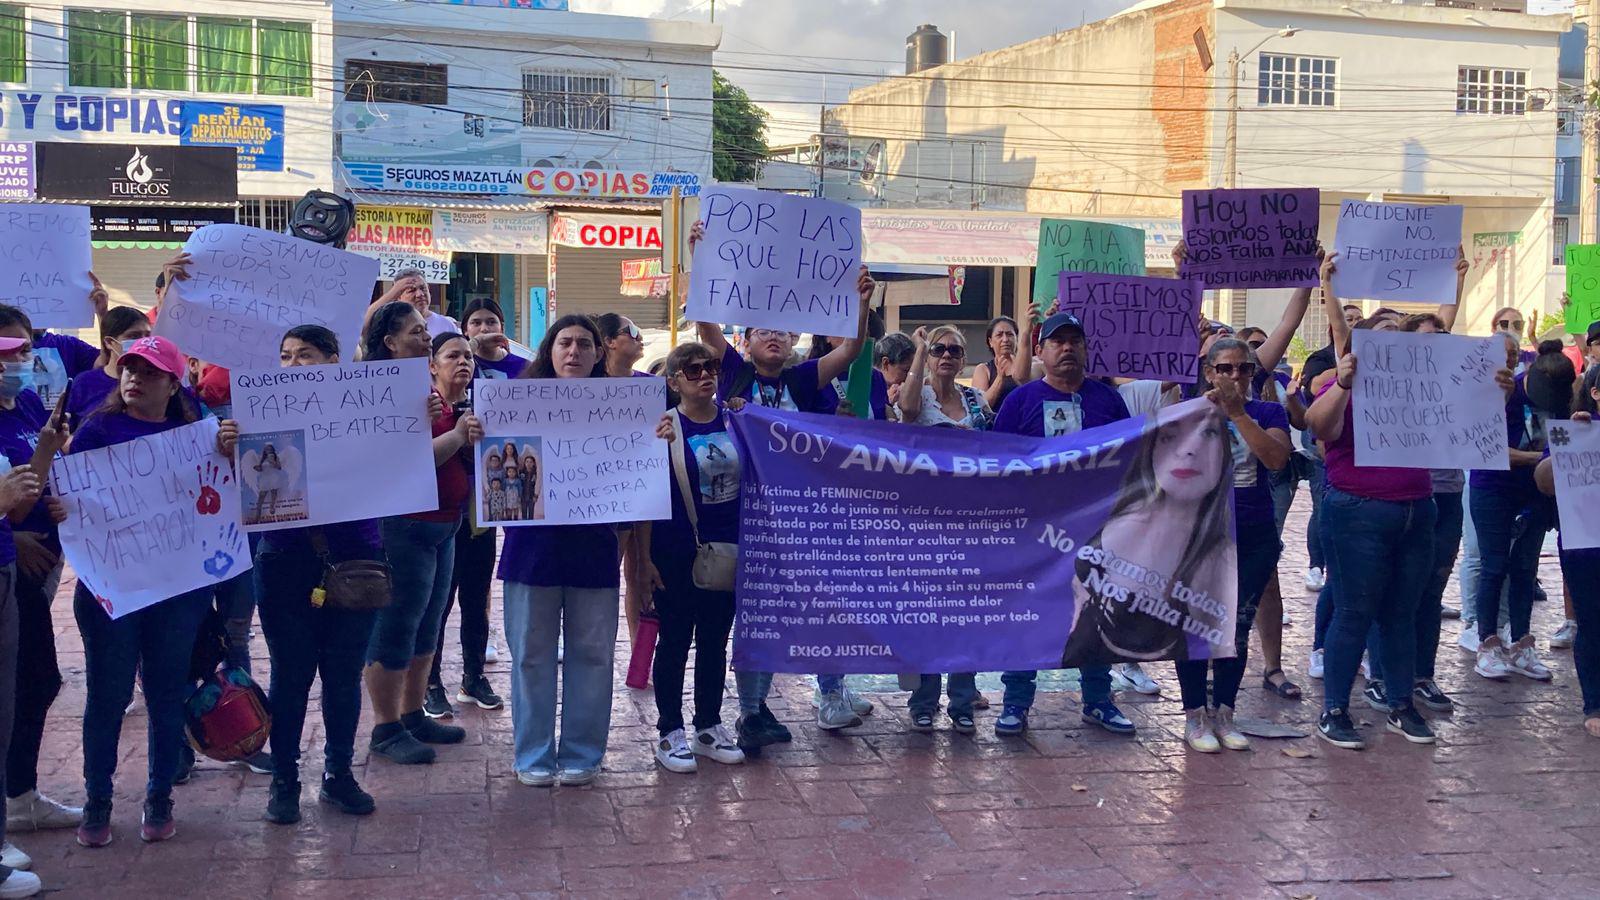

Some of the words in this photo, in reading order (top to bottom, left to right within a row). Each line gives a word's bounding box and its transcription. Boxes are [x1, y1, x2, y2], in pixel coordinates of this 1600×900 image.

[17, 93, 42, 129] Y
[55, 95, 180, 136] COPIAS
[198, 114, 265, 126] RENTAN
[223, 106, 240, 116] SE
[192, 124, 271, 141] DEPARTAMENTOS
[386, 167, 450, 181] SEGUROS
[453, 169, 522, 184] MAZATLÁN
[527, 170, 650, 195] COPIAS
[112, 182, 169, 195] FUEGO'S
[650, 184, 681, 196] REPUE
[1260, 193, 1298, 215] NO
[1342, 202, 1435, 221] ACCIDENTE
[356, 209, 393, 223] ESTORÍA
[396, 211, 402, 223] Y
[705, 193, 778, 235] POR
[799, 208, 854, 251] LAS
[347, 224, 383, 244] BLAS
[1044, 224, 1072, 248] NO
[1084, 227, 1094, 251] A
[1099, 229, 1121, 254] LA
[196, 229, 223, 243] NO
[241, 233, 348, 277] ESTAMOS
[351, 244, 387, 252] GESTOR
[1183, 247, 1222, 264] NOS
[1346, 245, 1457, 262] FEMINICIDIO
[206, 249, 291, 280] TODAS
[304, 273, 348, 296] NOS
[719, 239, 780, 270] QUE
[797, 248, 853, 287] HOY
[19, 271, 66, 290] ANA
[193, 271, 255, 294] FALTA
[265, 283, 316, 307] ANA
[1383, 268, 1419, 291] SI
[1066, 275, 1194, 313] EXIGIMOS
[1117, 351, 1198, 377] BEATRIZ
[1362, 340, 1398, 373] QUE
[1405, 345, 1438, 374] SER
[238, 369, 325, 388] Queremos
[480, 384, 595, 406] QUEREMOS
[600, 384, 667, 402] JUSTICIA
[1420, 381, 1443, 403] NO
[247, 391, 325, 420] PARA
[340, 385, 395, 409] ANA
[483, 409, 538, 424] PARA
[548, 409, 575, 423] MI
[1363, 406, 1398, 427] NOS
[311, 415, 421, 441] BEATRIZ
[547, 431, 651, 459] VICTOR
[768, 420, 834, 463] Soy
[840, 444, 939, 477] ANA
[952, 437, 1126, 477] BEATRIZ
[1366, 431, 1391, 451] LA
[1395, 432, 1432, 449] VIDA
[53, 452, 103, 496] ELLA
[108, 437, 156, 481] NO
[549, 467, 594, 484] NOS
[549, 489, 557, 501] A
[567, 478, 648, 500] NUESTRA
[803, 486, 818, 498] de
[821, 487, 900, 501] FEMINICIDIO
[78, 497, 95, 529] A
[97, 484, 149, 522] ELLA
[161, 472, 187, 504] LA
[568, 500, 633, 519] MADRE
[770, 501, 809, 515] jueves
[812, 502, 828, 514] 26
[831, 503, 846, 514] de
[848, 503, 879, 517] junio
[883, 504, 898, 514] mi
[902, 505, 930, 516] vida
[933, 506, 953, 516] fue
[956, 506, 1026, 516] cruelmente
[744, 517, 806, 529] arrebatada
[810, 520, 829, 532] por
[833, 519, 847, 530] mi
[851, 519, 905, 532] ESPOSO,
[909, 519, 943, 533] quien
[946, 521, 965, 530] me
[968, 518, 1012, 532] infligió
[1014, 518, 1028, 529] 17
[86, 508, 195, 573] MATARON
[744, 532, 808, 546] apuñaladas
[812, 535, 843, 545] antes
[846, 534, 861, 546] de
[864, 535, 914, 547] intentar
[917, 534, 962, 546] ocultar
[965, 536, 979, 545] su
[982, 535, 1016, 545] atroz
[1038, 523, 1075, 553] No
[745, 547, 777, 560] crimen
[780, 549, 862, 561] estrellándose
[864, 551, 905, 562] contra
[908, 553, 932, 561] una
[935, 550, 965, 563] grúa
[779, 566, 829, 580] agonice
[832, 566, 884, 577] mientras
[887, 565, 958, 577] lentamente
[962, 567, 981, 576] me
[743, 578, 811, 593] desangraba
[814, 580, 864, 595] dejando
[878, 582, 898, 593] mis
[913, 581, 943, 595] hijos
[946, 581, 964, 592] sin
[967, 582, 981, 592] su
[984, 579, 1023, 590] mamá
[742, 596, 757, 606] mis
[759, 596, 797, 609] padre
[811, 596, 875, 609] familiares
[877, 600, 892, 609] un
[969, 596, 1003, 607] dolor
[1083, 567, 1130, 603] Nos
[1182, 615, 1224, 645] una
[741, 611, 777, 625] Quiero
[781, 615, 805, 627] que
[808, 613, 824, 625] mi
[828, 612, 888, 625] AGRESOR
[891, 612, 938, 624] VICTOR
[942, 614, 981, 627] pague
[984, 612, 1006, 625] por
[1009, 610, 1039, 622] todo
[751, 628, 781, 639] daño
[789, 645, 832, 657] EXIGO
[835, 644, 893, 657] JUSTICIA
